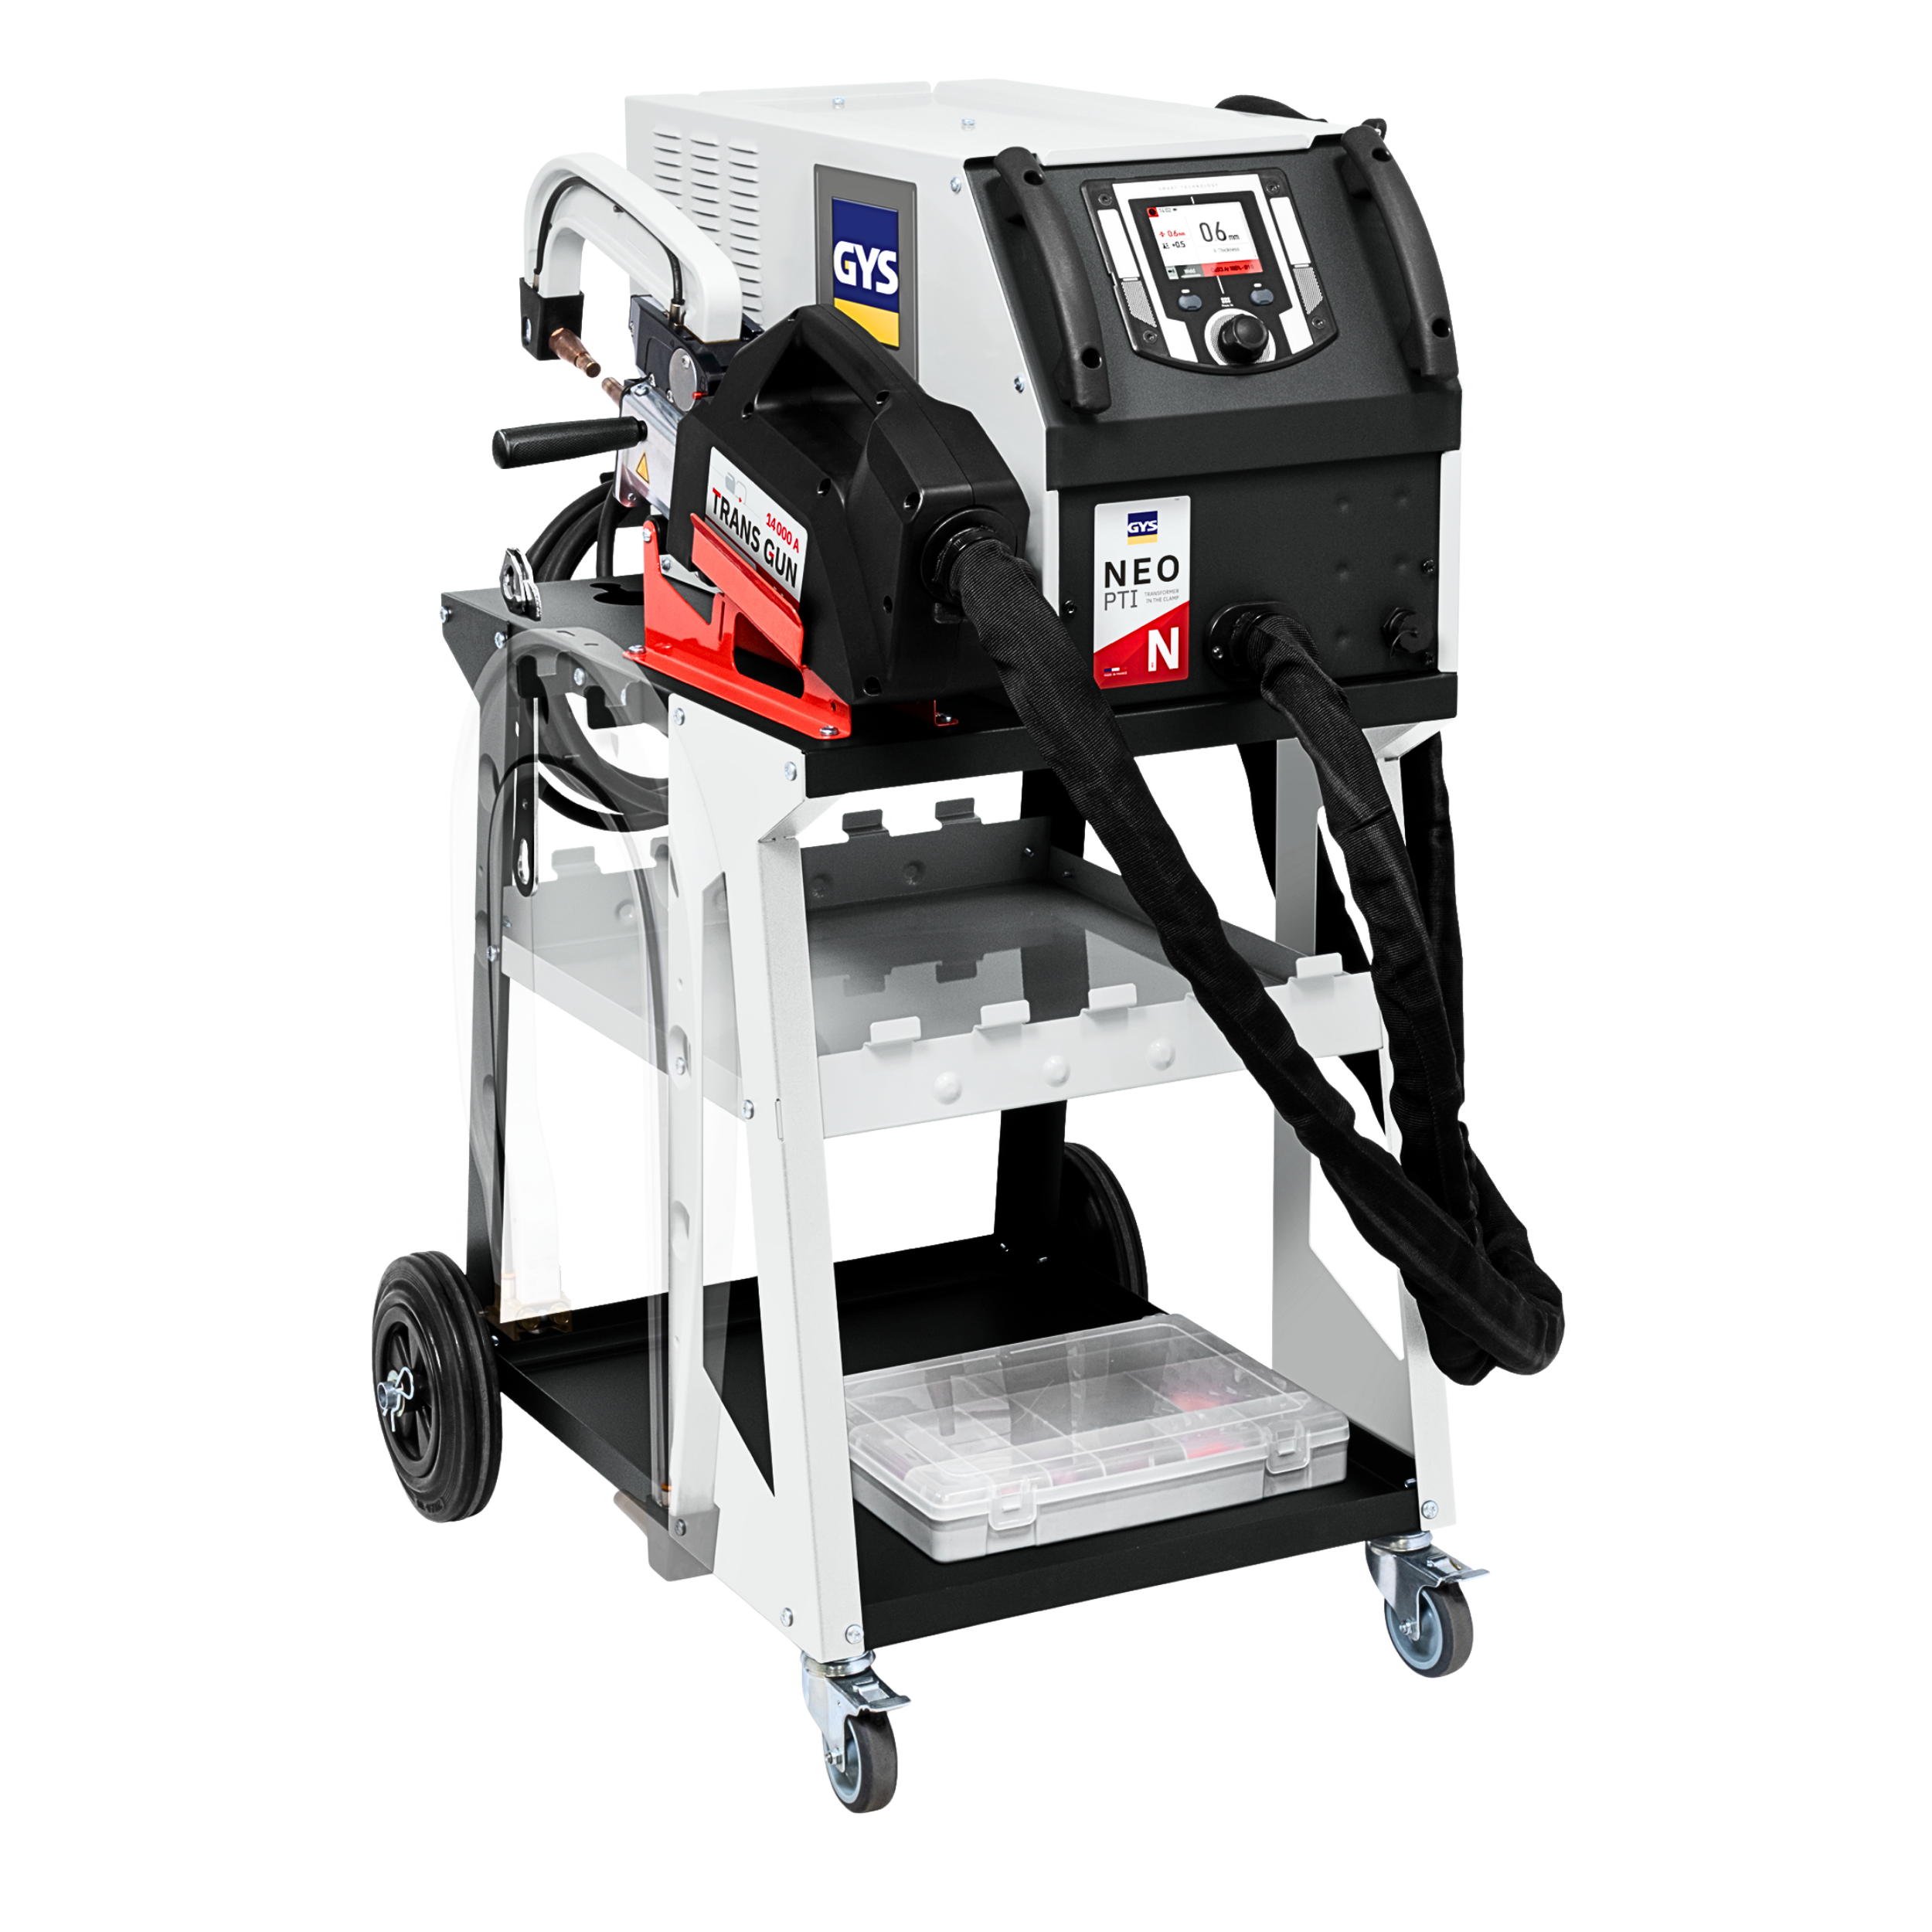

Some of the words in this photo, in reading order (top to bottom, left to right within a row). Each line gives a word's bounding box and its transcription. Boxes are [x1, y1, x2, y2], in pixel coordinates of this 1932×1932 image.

[833, 240, 899, 295] GYS
[713, 487, 760, 553] TRANS
[764, 538, 798, 589] GUN
[1128, 520, 1158, 533] GYS
[1105, 555, 1179, 588] NEO
[1104, 590, 1138, 611] PTI
[1144, 588, 1179, 597] TRANSFORMER
[1148, 627, 1179, 672] N
